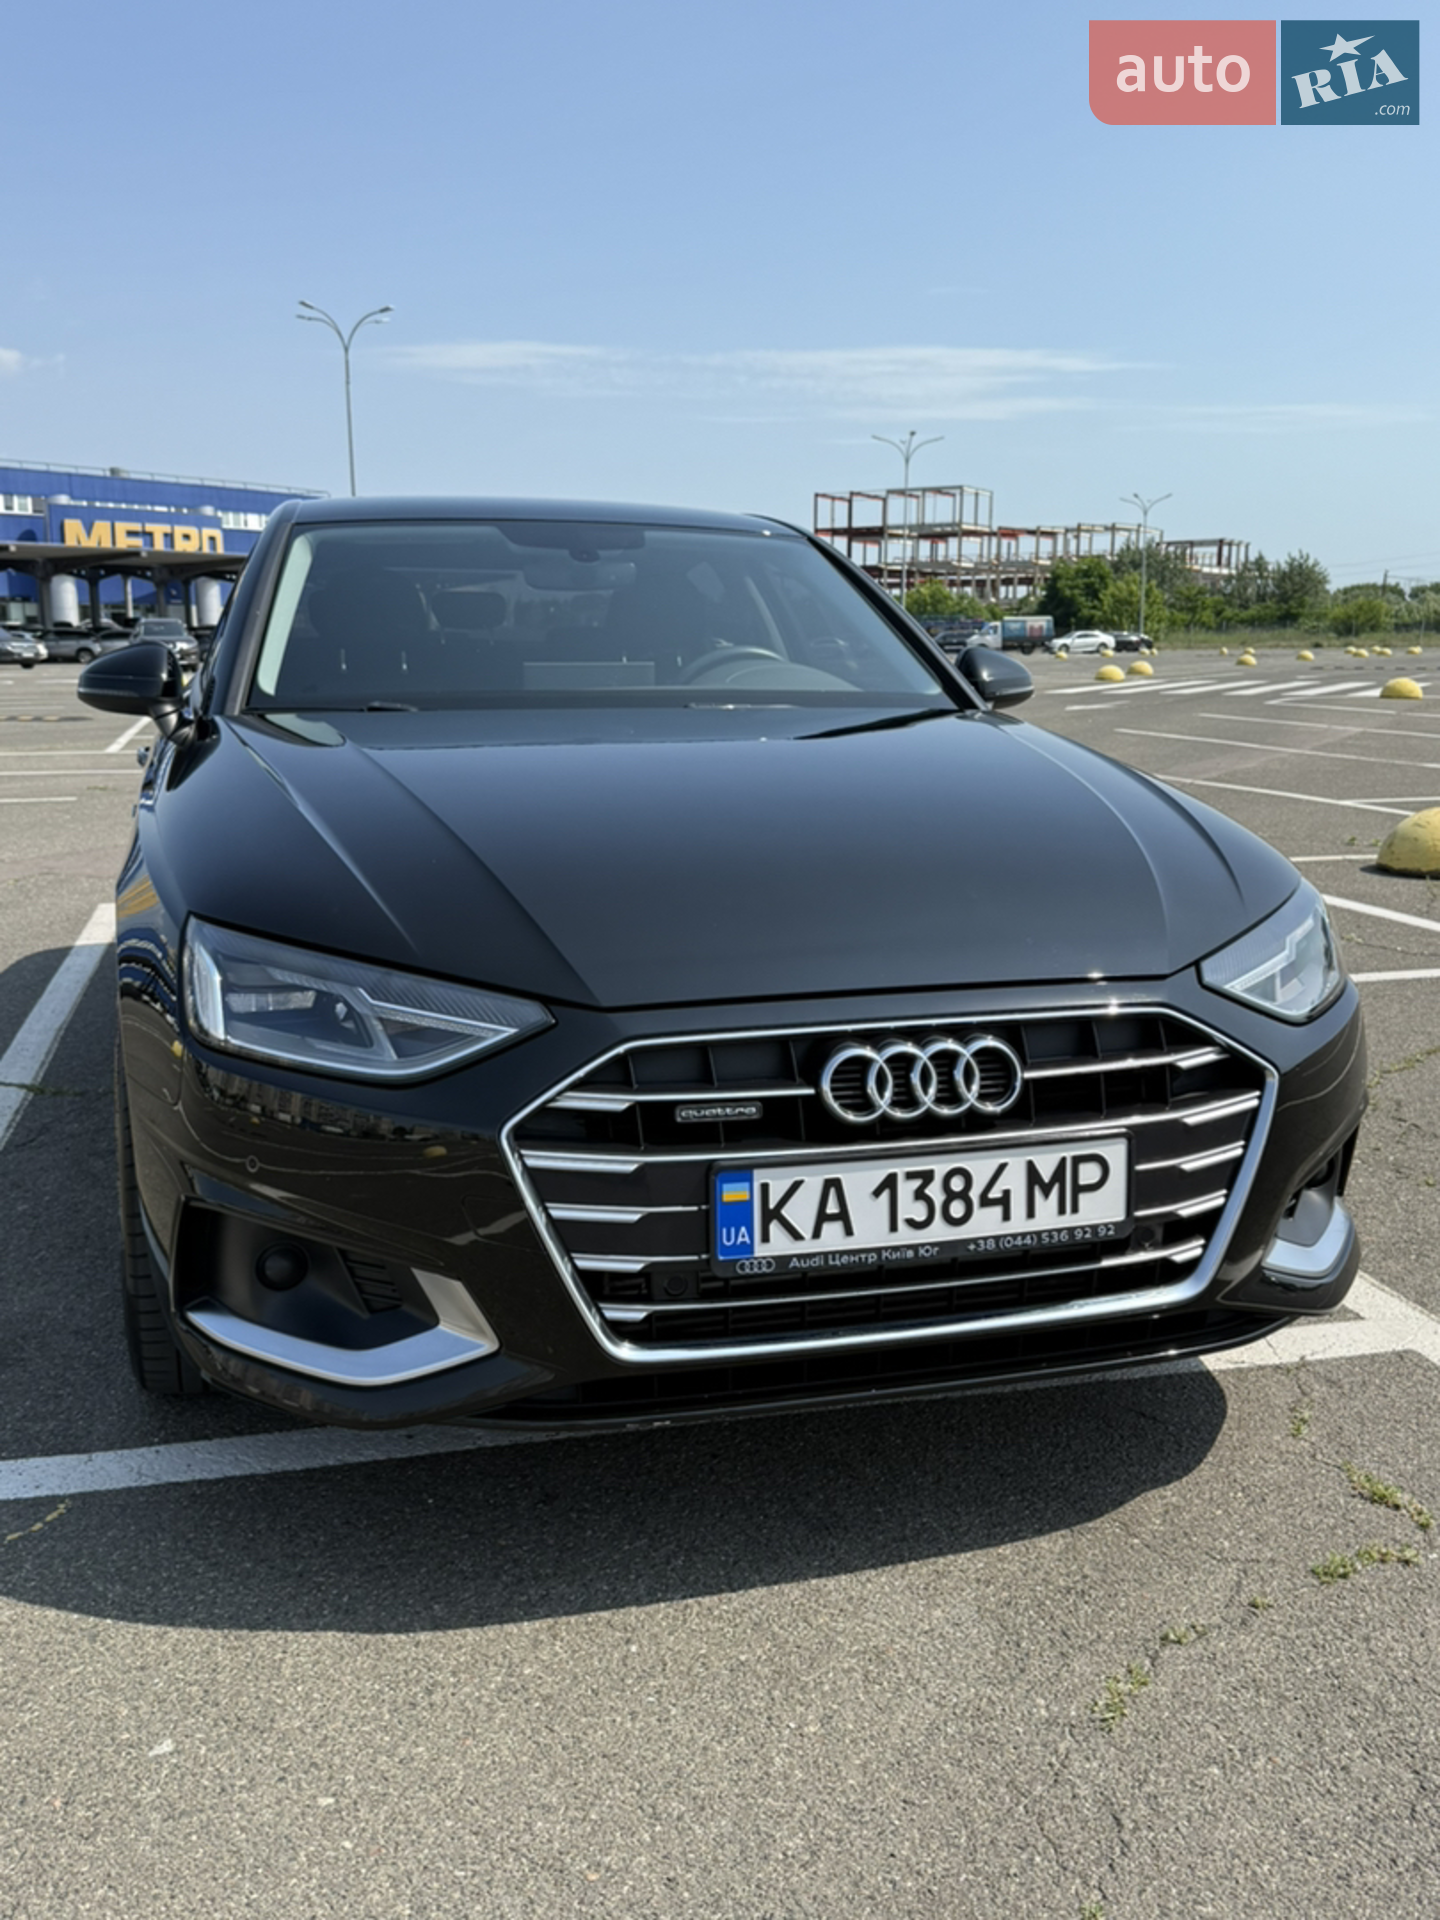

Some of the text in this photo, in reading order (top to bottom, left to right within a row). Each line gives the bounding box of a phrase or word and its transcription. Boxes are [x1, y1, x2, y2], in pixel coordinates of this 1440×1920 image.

[63, 518, 225, 554] METRO
[680, 1106, 757, 1119] quattro
[759, 1152, 1111, 1244] KA 1384 MP
[721, 1225, 751, 1246] UA
[967, 1223, 1116, 1251] +38 (044) 536 92 92
[788, 1245, 940, 1269] Audi Центр Київ Юг
